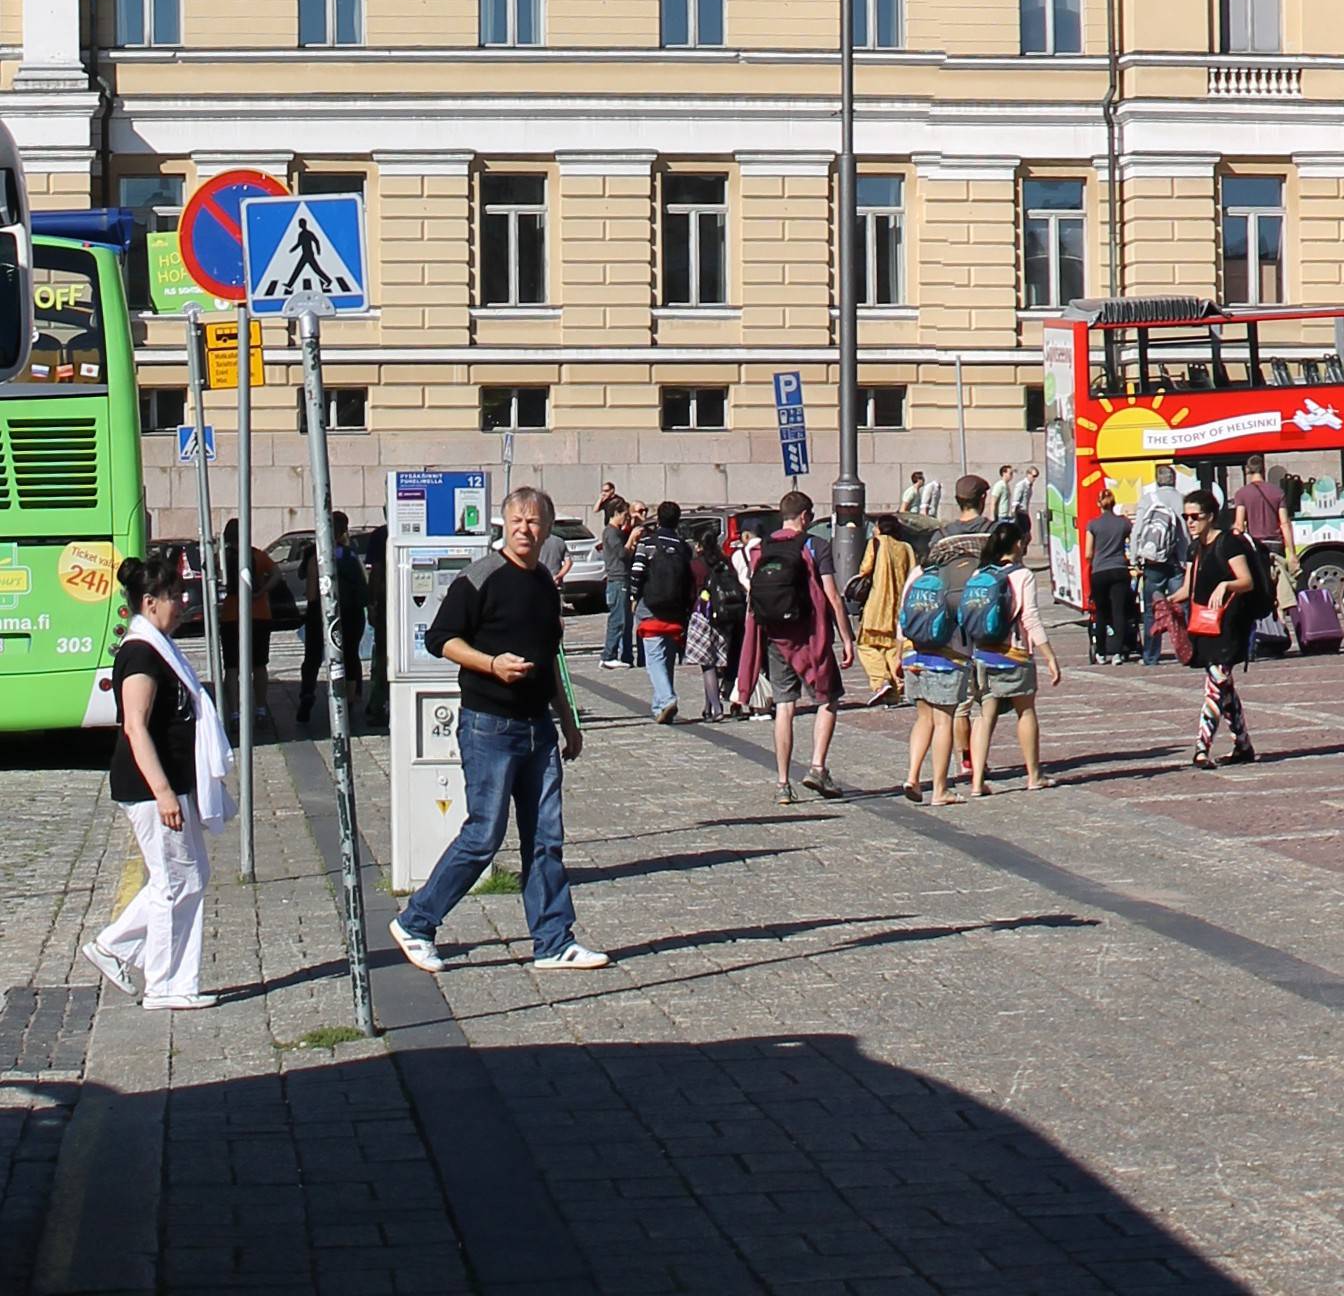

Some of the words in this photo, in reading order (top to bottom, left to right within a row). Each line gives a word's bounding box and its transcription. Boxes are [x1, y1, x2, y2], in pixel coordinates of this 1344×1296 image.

[34, 284, 84, 311] OFF
[779, 374, 798, 405] P
[1147, 435, 1168, 445] THE
[1171, 431, 1206, 445] STORY
[1209, 426, 1224, 438] OF
[1227, 418, 1277, 433] HELSINKI
[467, 476, 482, 487] 12
[66, 565, 109, 595] 24h
[56, 637, 93, 653] 303
[432, 723, 451, 737] 45
